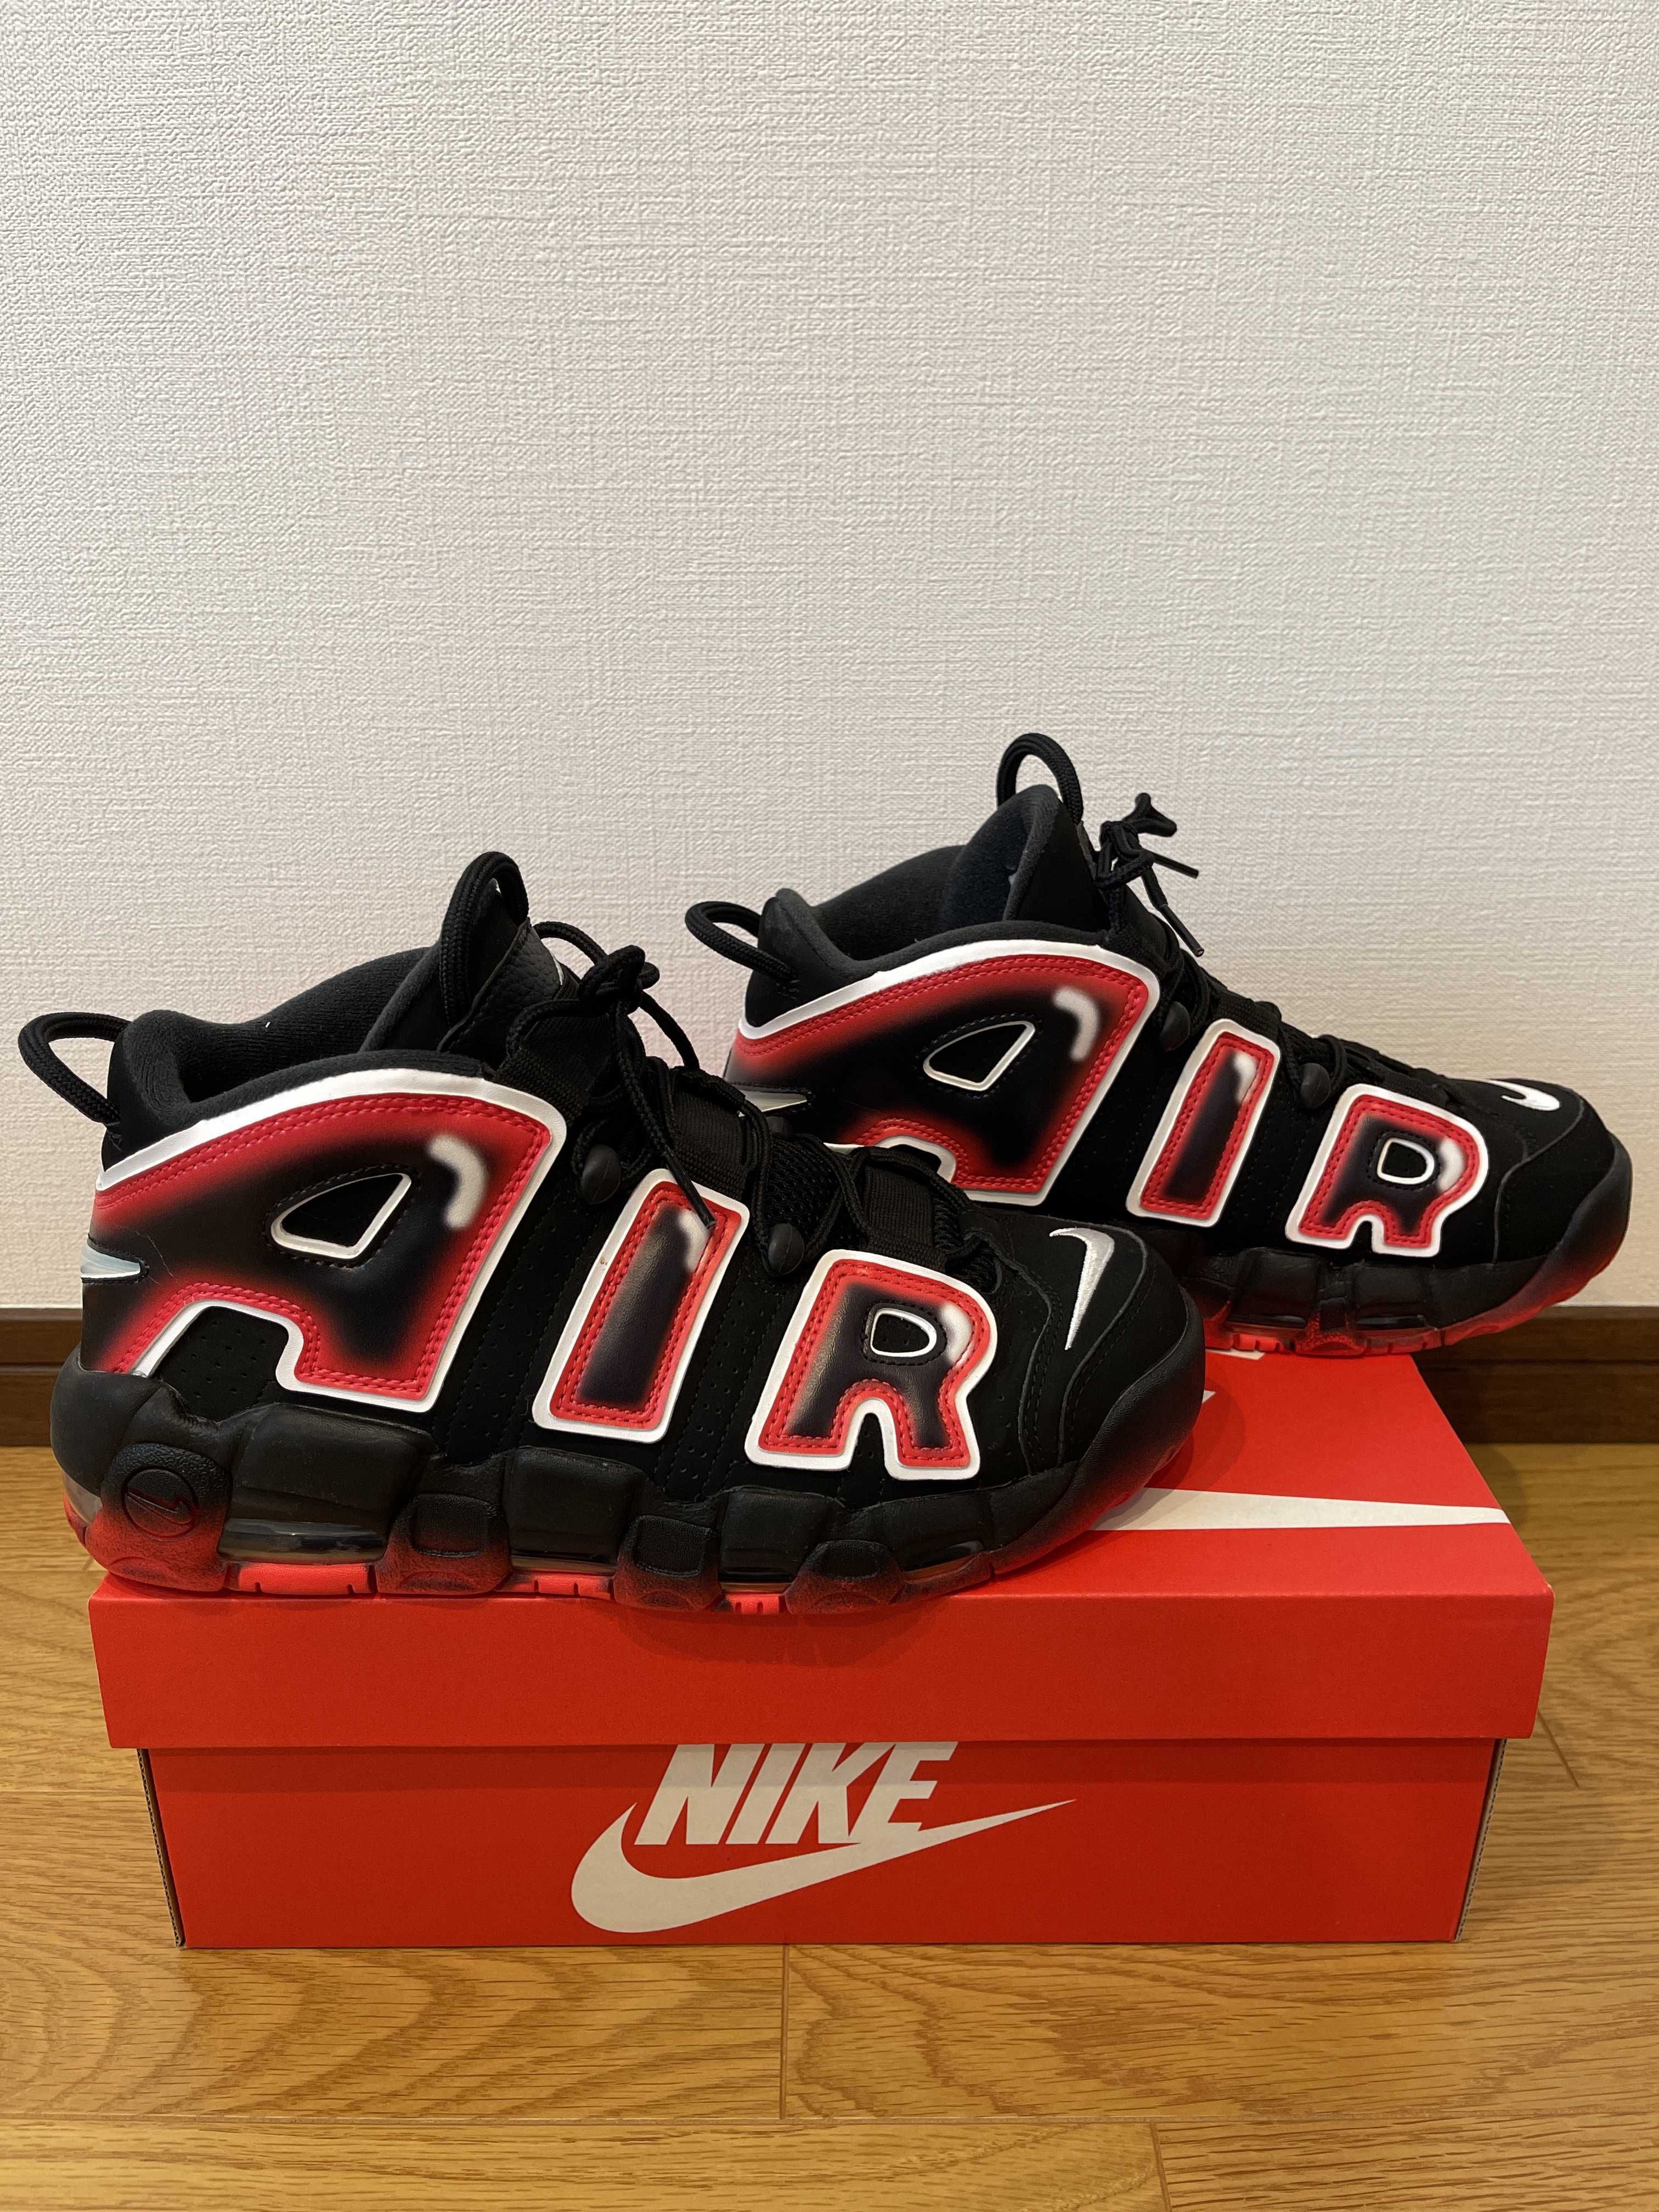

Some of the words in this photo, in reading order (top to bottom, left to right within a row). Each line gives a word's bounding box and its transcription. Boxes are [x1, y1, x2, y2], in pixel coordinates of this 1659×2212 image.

[727, 938, 1489, 1256] AIR
[81, 1068, 998, 1481] AIR
[634, 1741, 958, 1845] NIKE
